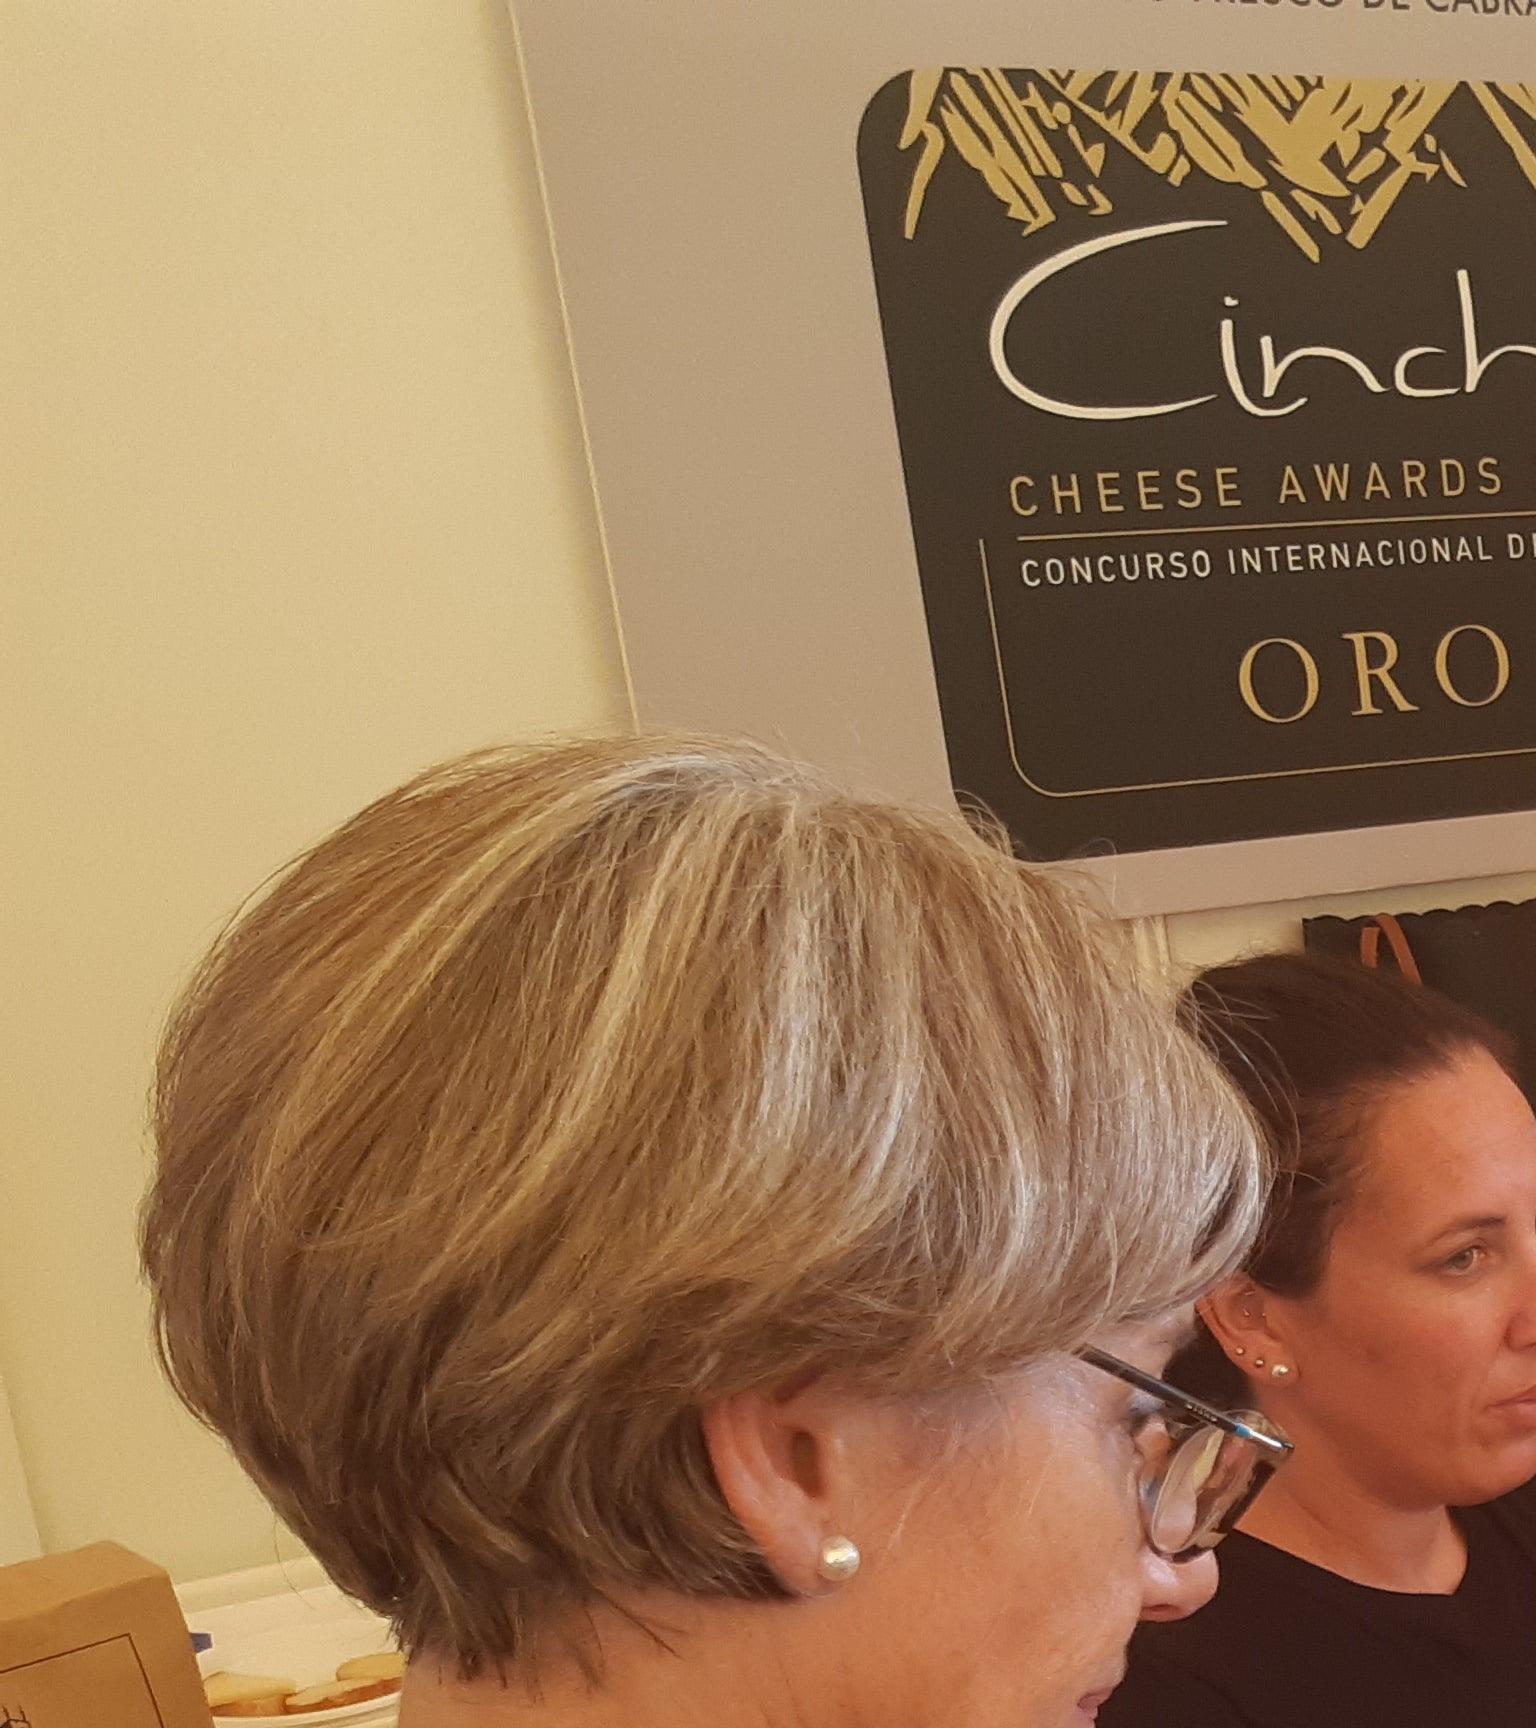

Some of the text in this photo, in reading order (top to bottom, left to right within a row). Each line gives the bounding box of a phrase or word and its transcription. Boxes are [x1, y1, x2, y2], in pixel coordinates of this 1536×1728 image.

[1010, 466, 1243, 516] CHEESE
[1279, 457, 1502, 504] AWARDS
[1021, 549, 1212, 588] CONCURSO
[1228, 535, 1493, 575] INTERNACIONAL
[1238, 623, 1511, 724] ORO
